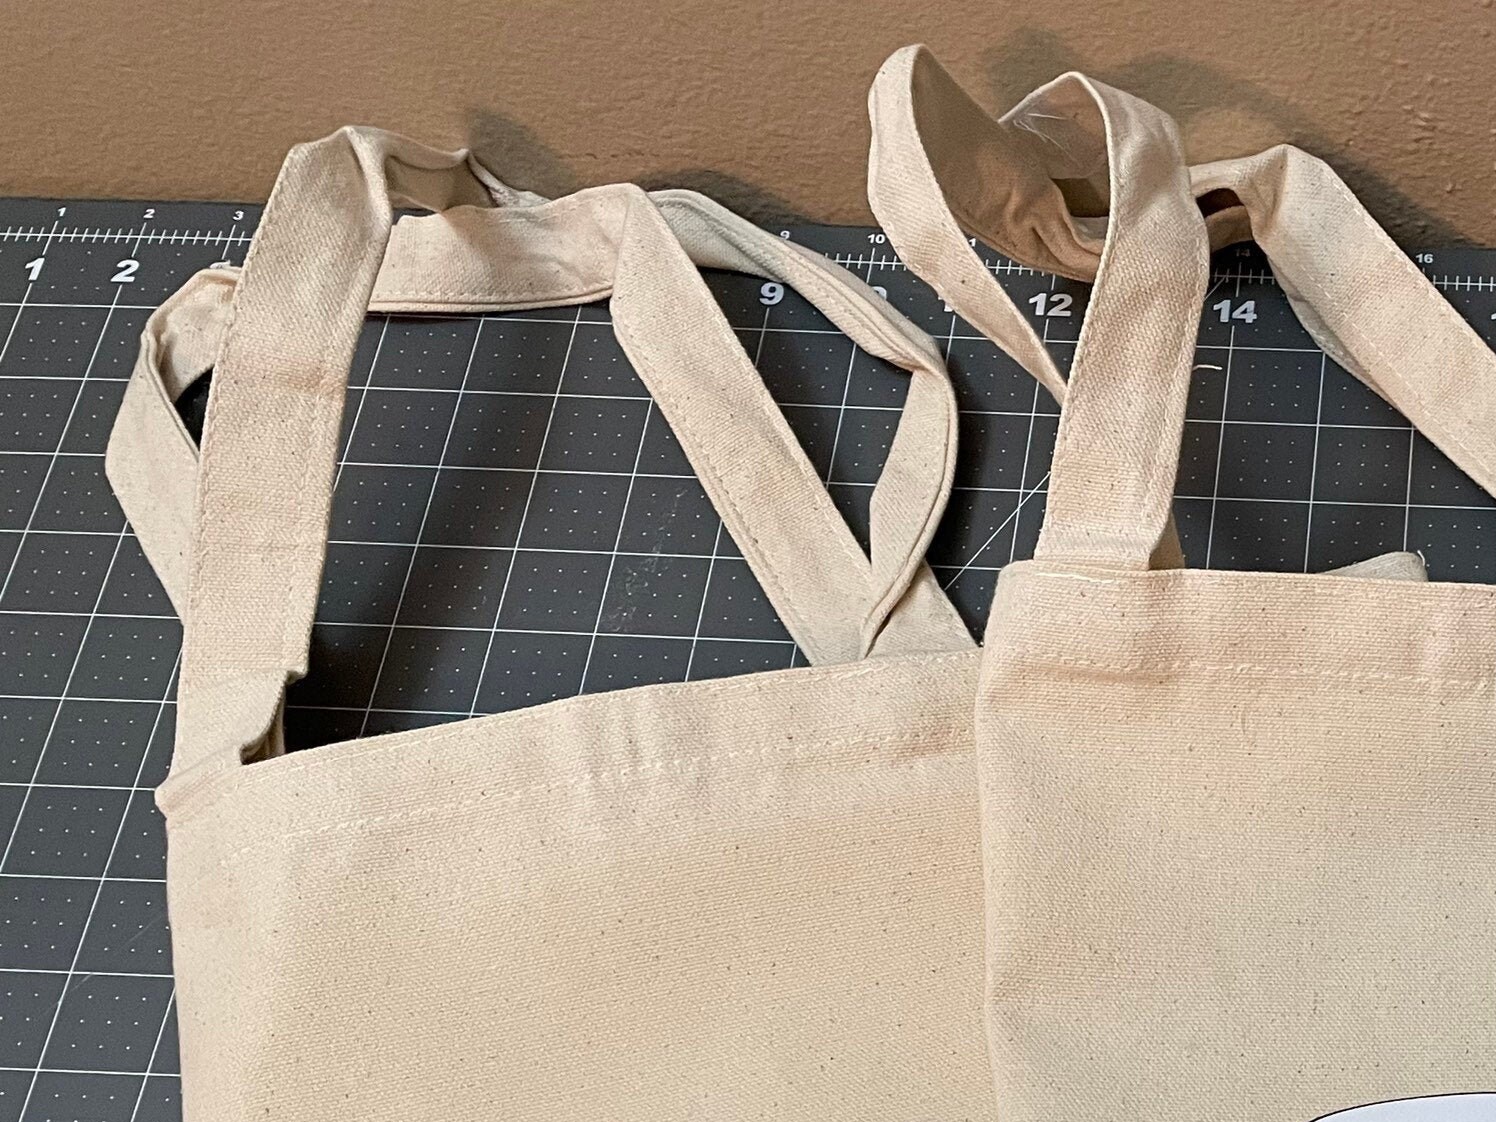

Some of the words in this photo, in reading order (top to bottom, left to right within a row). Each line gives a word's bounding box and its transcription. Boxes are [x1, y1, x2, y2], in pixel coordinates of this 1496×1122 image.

[57, 207, 67, 217] 1
[143, 208, 156, 219] 2
[232, 210, 245, 221] 3
[867, 233, 886, 244] 10
[1415, 253, 1434, 265] 16
[24, 257, 46, 281] 1
[110, 259, 140, 283] 2
[759, 282, 785, 306] 9
[1028, 292, 1073, 317] 12
[1212, 299, 1258, 324] 14
